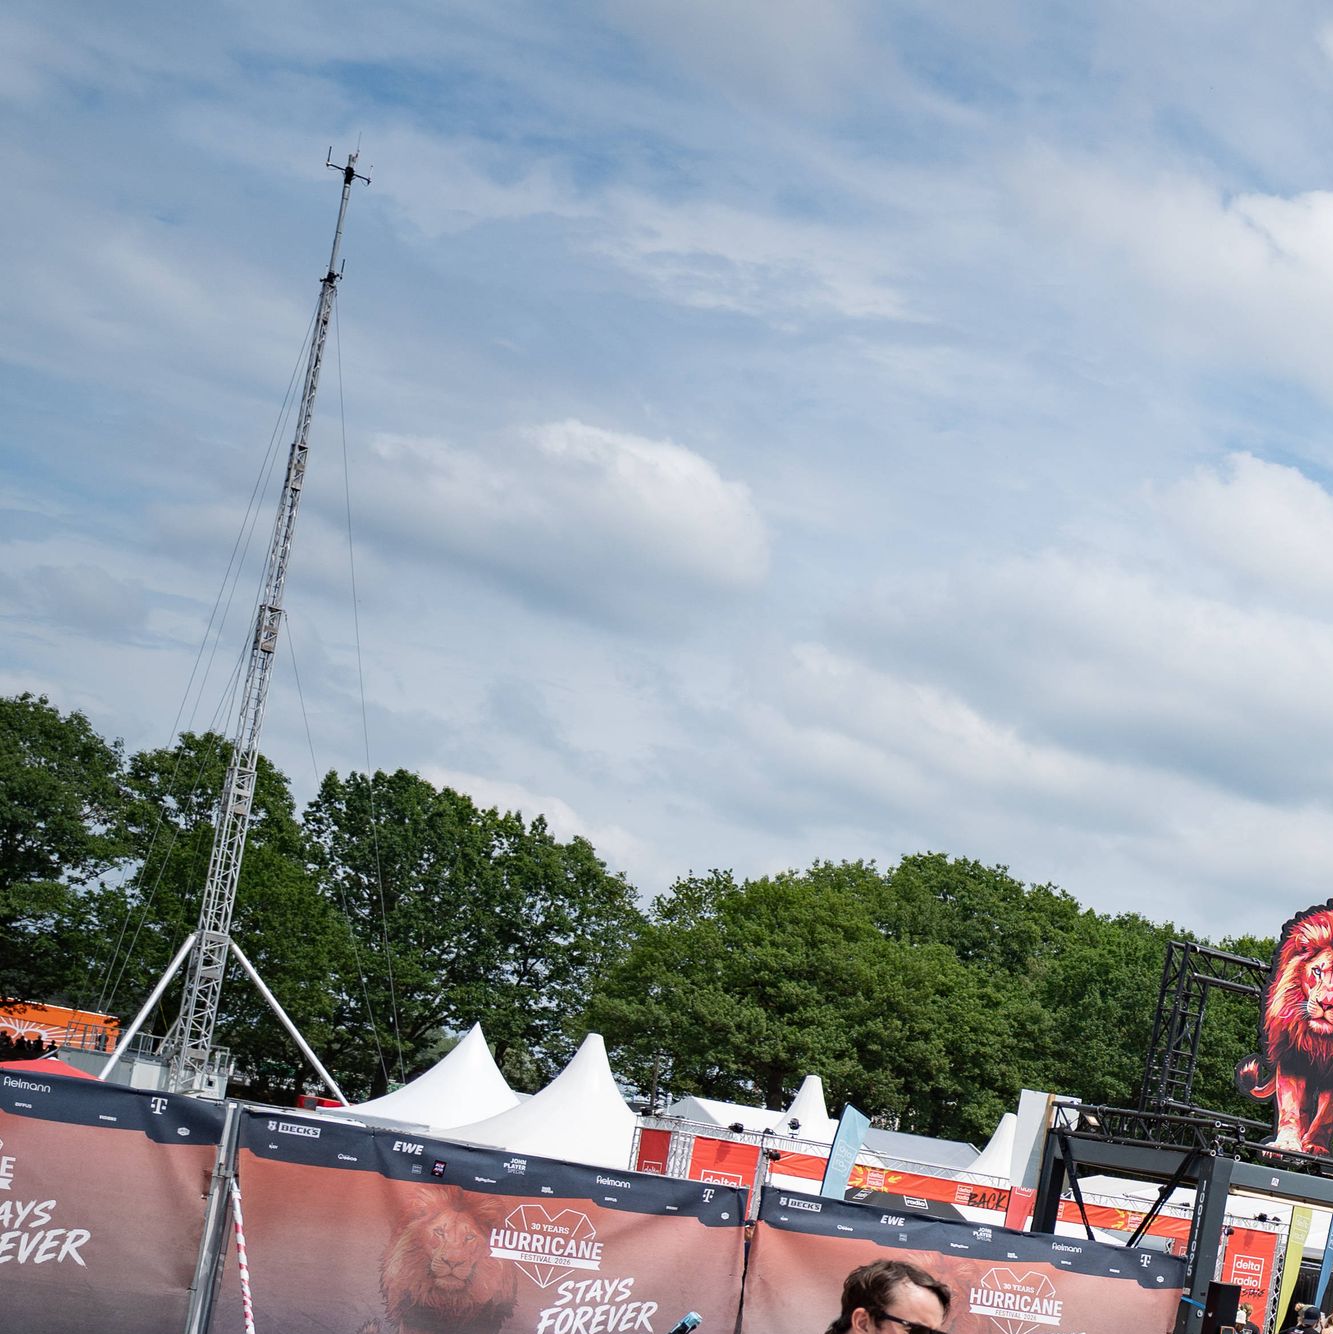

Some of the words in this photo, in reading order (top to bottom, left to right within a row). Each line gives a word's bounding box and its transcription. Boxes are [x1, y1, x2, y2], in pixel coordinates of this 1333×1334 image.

[281, 1124, 320, 1136] BECK'S
[393, 1141, 424, 1155] EWE
[503, 1162, 526, 1171] PLAYER
[510, 1157, 527, 1165] JOHN
[967, 1191, 1008, 1211] BACK
[0, 1199, 56, 1228] AYS
[881, 1215, 906, 1227] EWE
[531, 1222, 541, 1231] 30
[543, 1223, 570, 1235] YEARS
[0, 1229, 91, 1270] EVER
[489, 1228, 605, 1260] HURRICANE
[520, 1253, 552, 1264] FESTIVAL
[554, 1257, 571, 1266] 2026
[1235, 1259, 1260, 1271] delta
[1233, 1276, 1259, 1287] radio
[553, 1277, 635, 1306] STAYS
[1012, 1284, 1035, 1294] YEARS
[969, 1287, 1063, 1317] HURRICANE
[995, 1310, 1021, 1319] FESTIVAL
